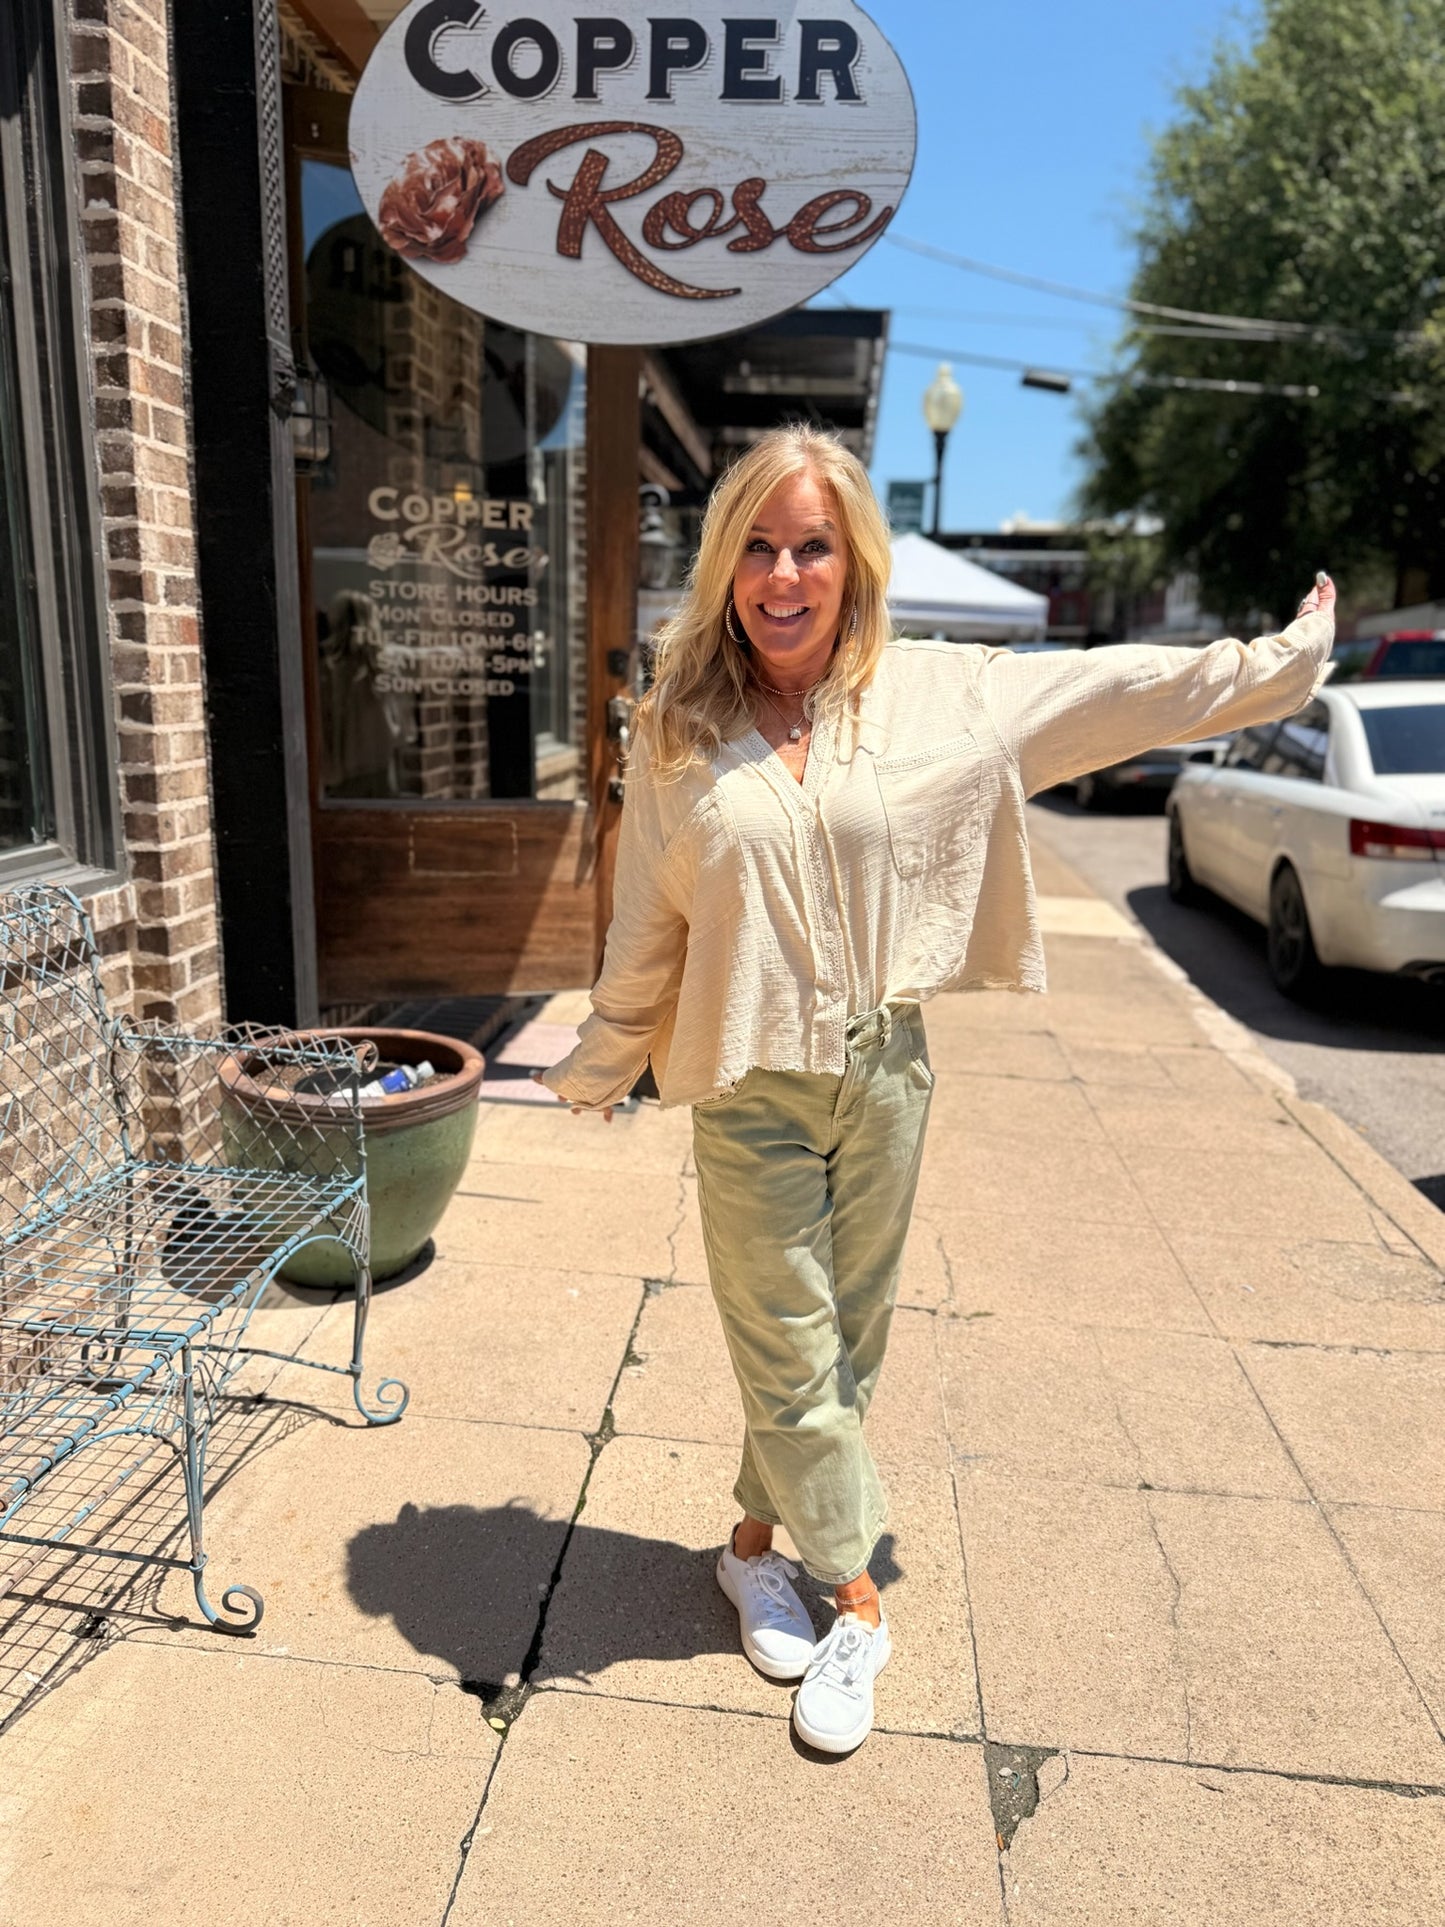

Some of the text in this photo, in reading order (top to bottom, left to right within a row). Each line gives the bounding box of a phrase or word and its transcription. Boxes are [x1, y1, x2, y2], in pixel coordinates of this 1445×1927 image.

[404, 0, 868, 102] COPPER
[506, 120, 893, 300] Rose
[368, 486, 534, 531] COPPER
[403, 523, 540, 580] Rose
[369, 580, 538, 606] STORE HOURS
[430, 609, 515, 628] CLOSED
[430, 678, 515, 696] CLOSED
